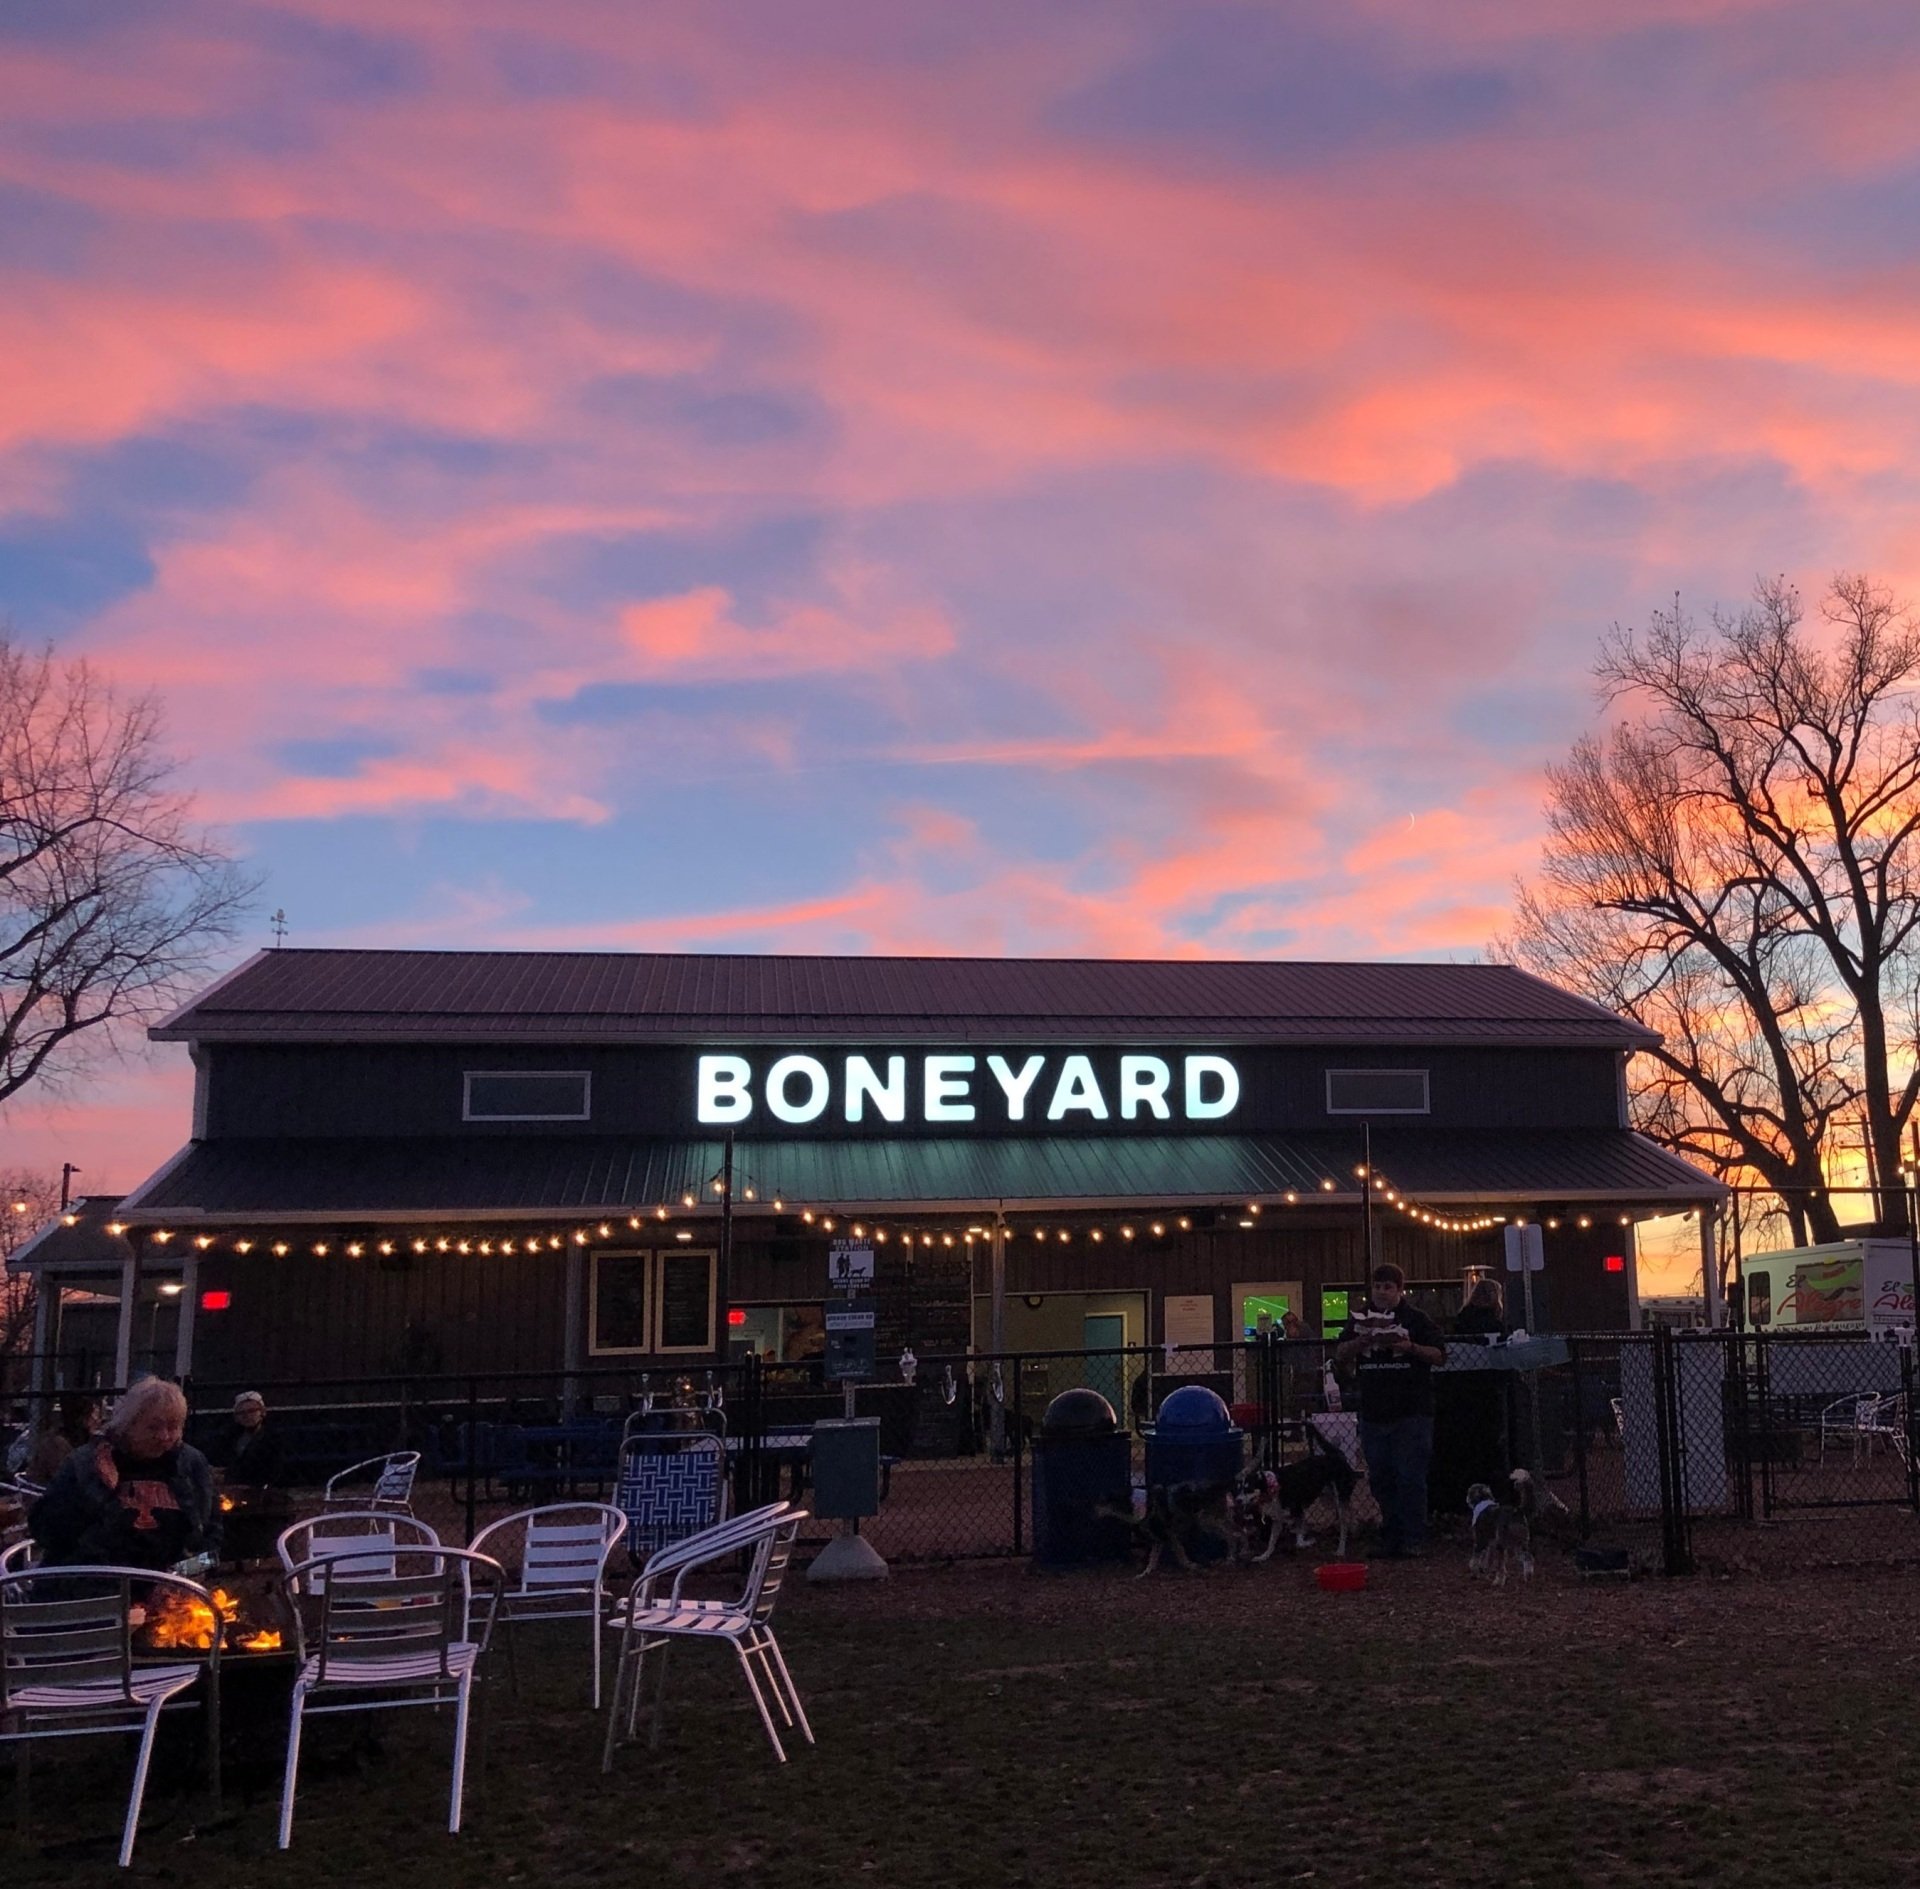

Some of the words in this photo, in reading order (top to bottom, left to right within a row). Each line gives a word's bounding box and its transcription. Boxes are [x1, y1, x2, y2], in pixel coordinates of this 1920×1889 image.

[697, 1055, 1240, 1123] BONEYARD
[1786, 1274, 1806, 1288] El
[1881, 1281, 1901, 1293] El
